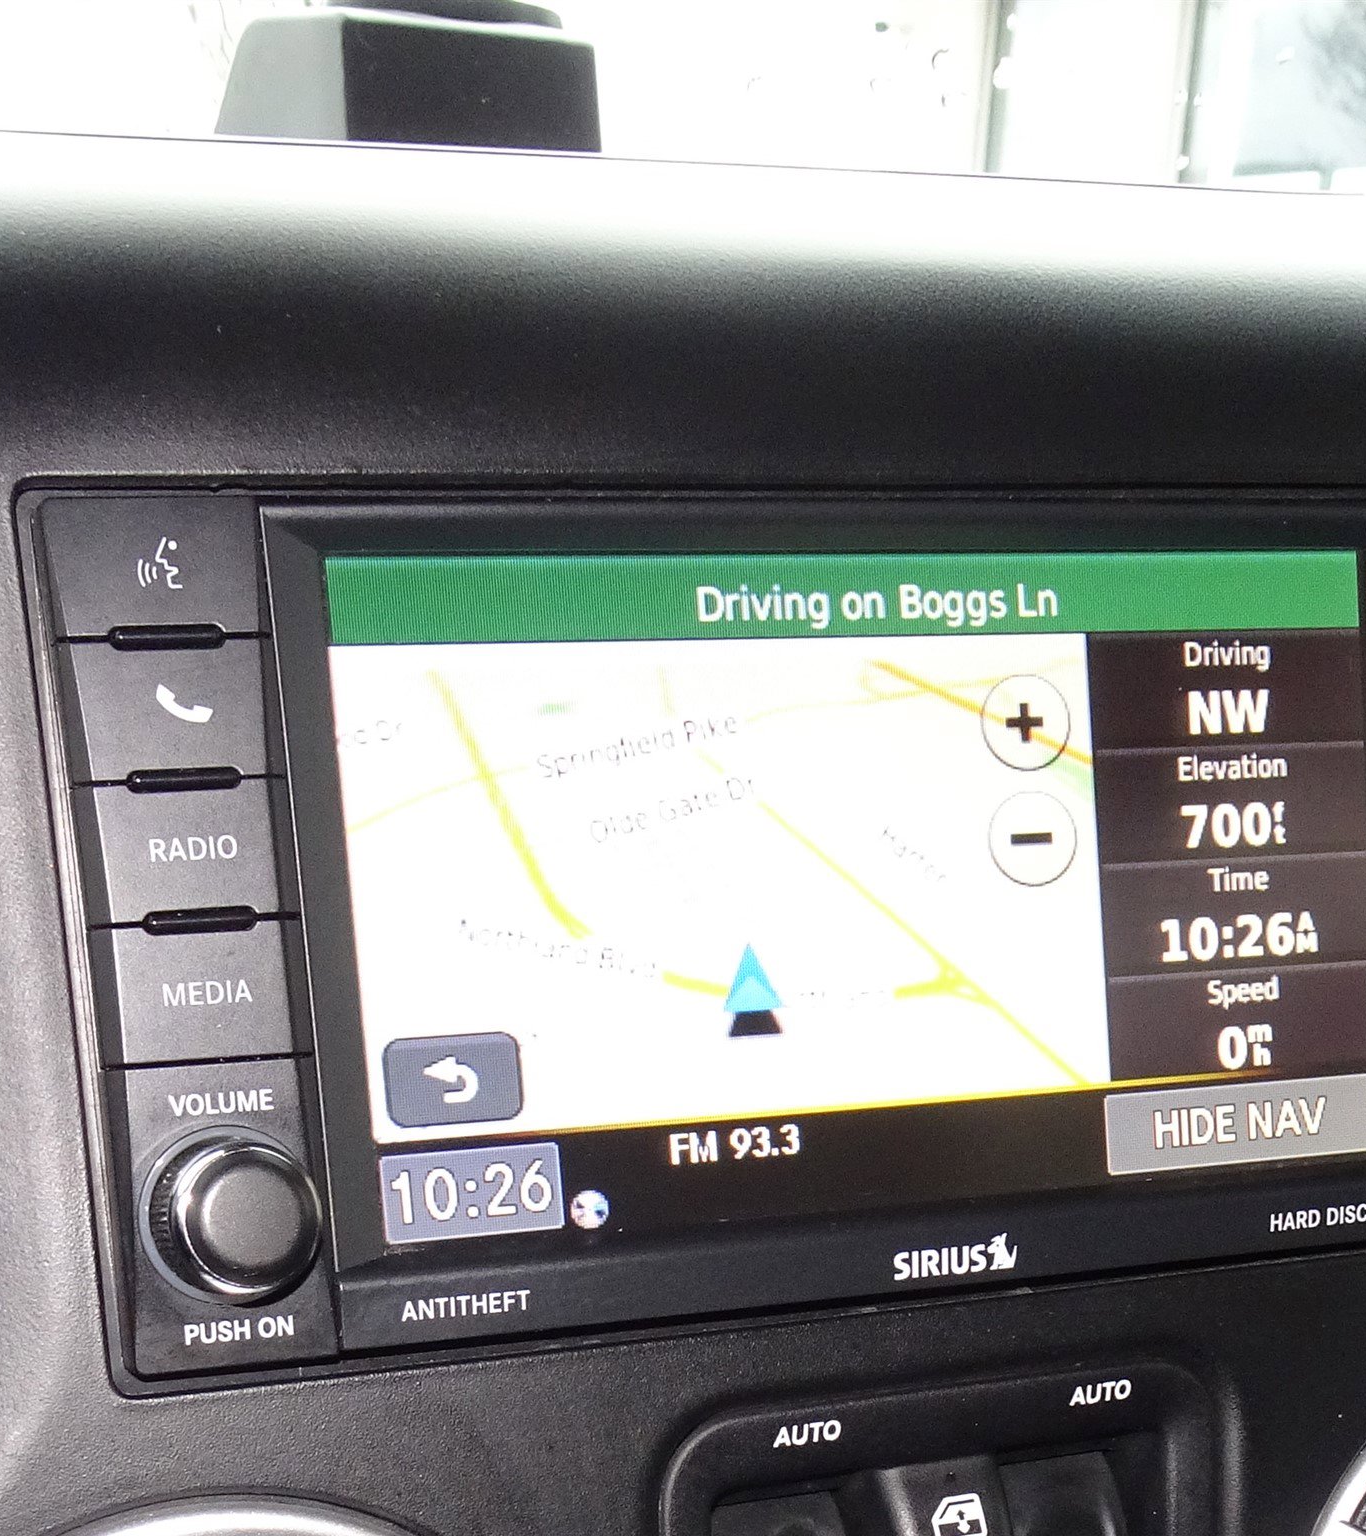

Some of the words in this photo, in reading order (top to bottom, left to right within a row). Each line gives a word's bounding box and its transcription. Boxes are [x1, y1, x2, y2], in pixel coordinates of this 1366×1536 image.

[695, 583, 831, 630] Driving
[840, 590, 887, 622] on
[898, 583, 1009, 628] Boggs
[1016, 583, 1059, 618] Ln
[1182, 639, 1272, 674] Driving
[1185, 687, 1271, 736] NW
[682, 715, 738, 744] Pike
[1176, 752, 1289, 783] Elevation
[147, 834, 239, 864] RADIO
[1206, 865, 1271, 893] Time
[160, 978, 254, 1008] MEDIA
[1206, 974, 1281, 1006] Speed
[167, 1088, 276, 1118] VOLUME
[1151, 1105, 1237, 1149] HIDE
[1247, 1096, 1327, 1141] NAV
[667, 1130, 719, 1166] FM
[730, 1123, 803, 1160] 93.3
[389, 1160, 554, 1226] 10:26
[1268, 1209, 1322, 1234] HARD
[892, 1243, 990, 1282] SIRIUS
[400, 1289, 532, 1323] ANTITHEFT
[182, 1318, 253, 1347] PUSH
[257, 1314, 296, 1340] ON
[1068, 1379, 1133, 1408] AUTO
[771, 1419, 843, 1449] AUTO
